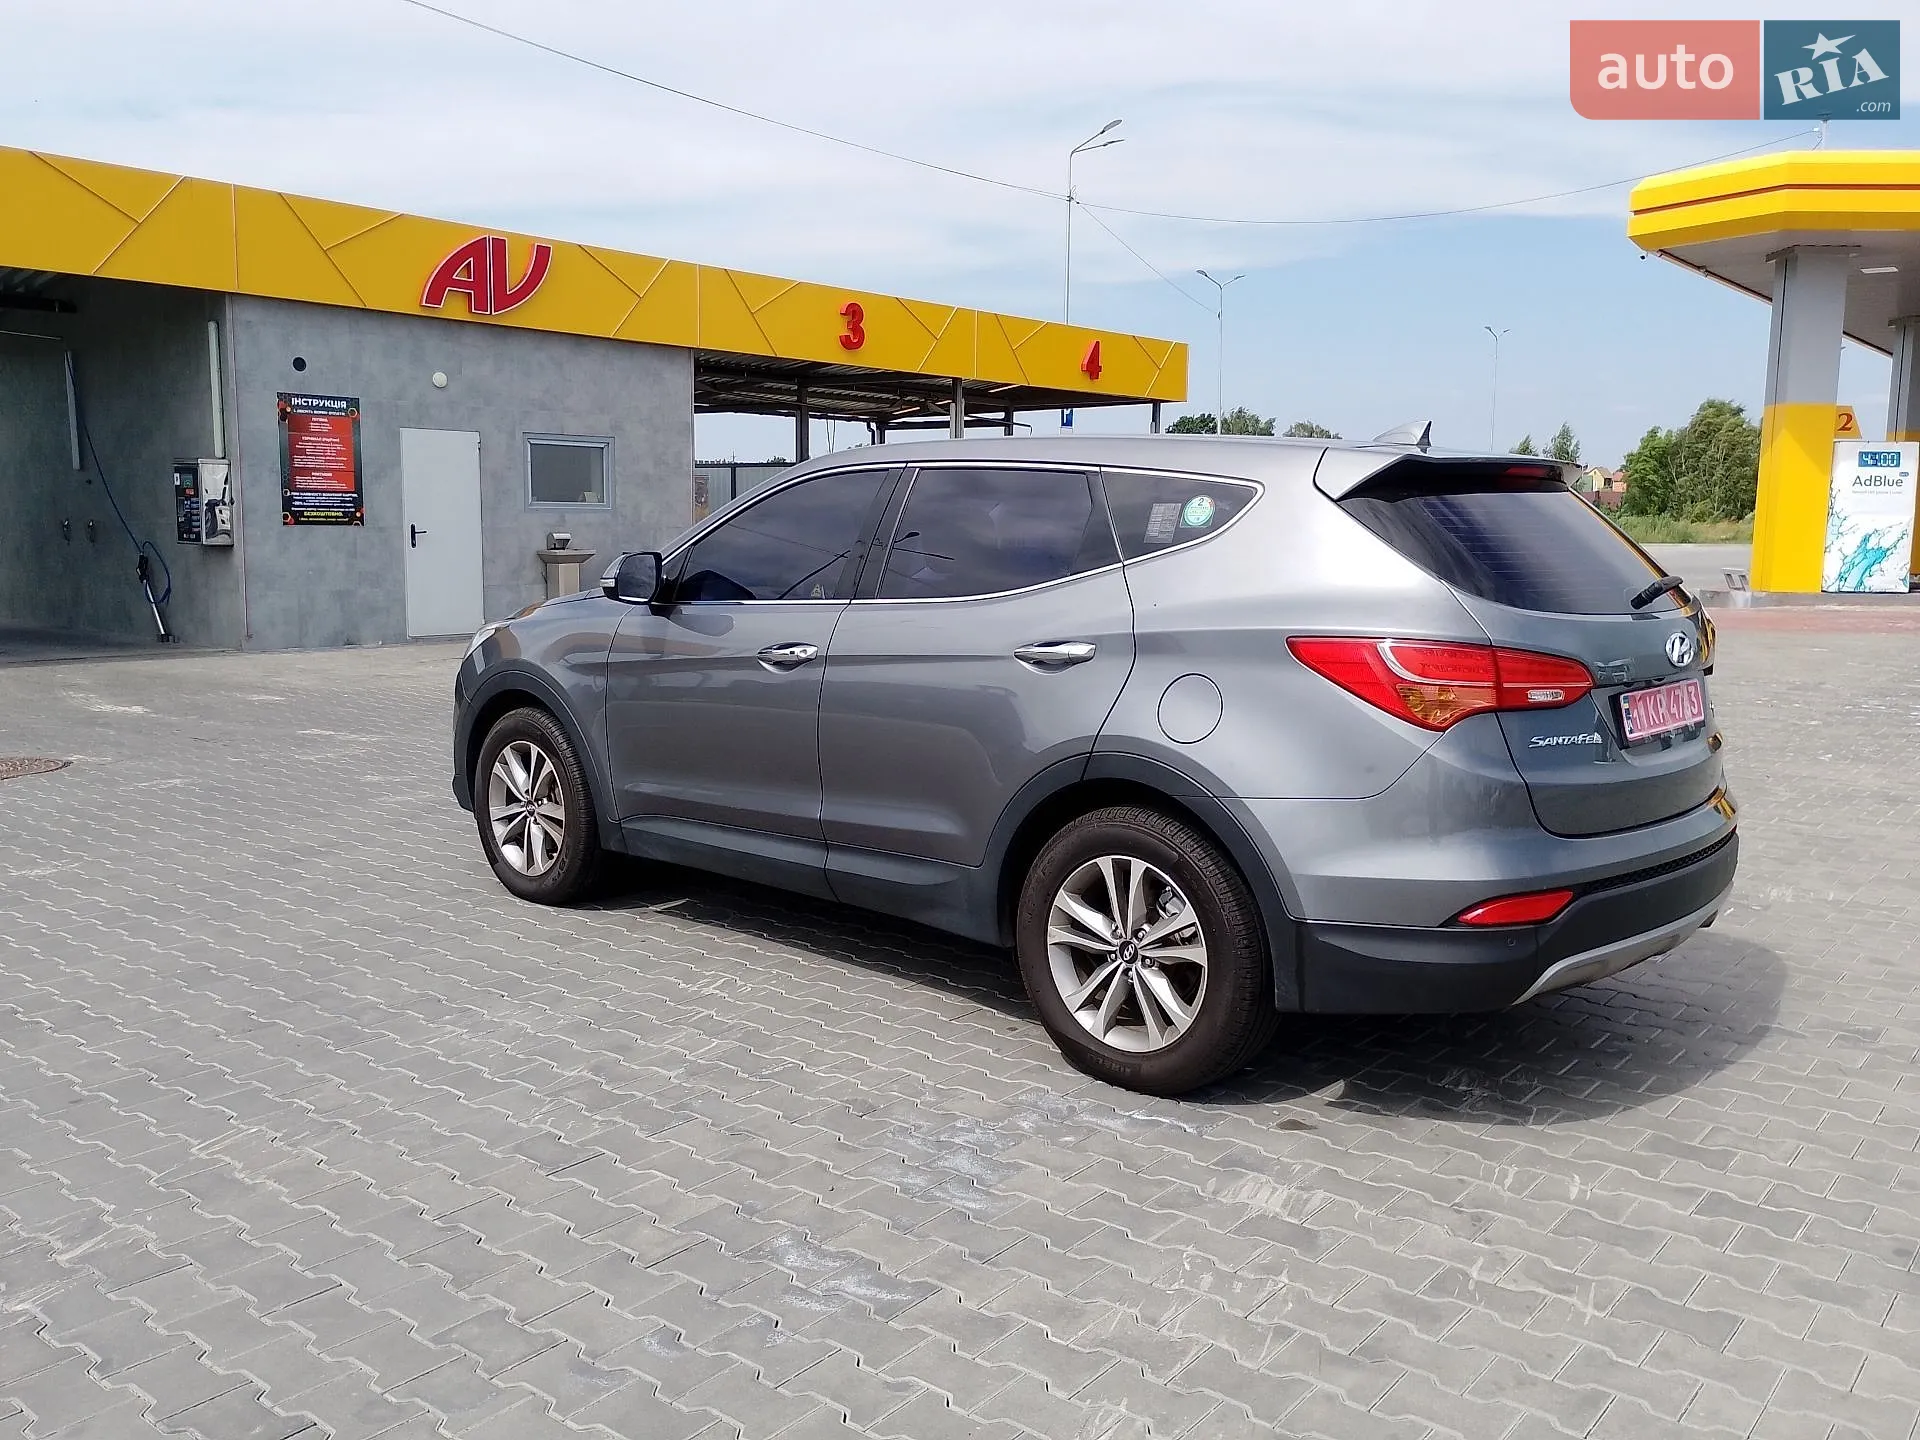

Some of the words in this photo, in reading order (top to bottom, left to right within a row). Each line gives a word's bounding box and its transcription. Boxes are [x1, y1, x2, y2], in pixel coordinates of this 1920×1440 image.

[839, 302, 865, 351] 3
[1081, 340, 1102, 380] 4
[291, 397, 347, 409] ІНСТРУКЦІЯ
[1837, 412, 1853, 431] 2
[1852, 474, 1904, 487] AdBlue
